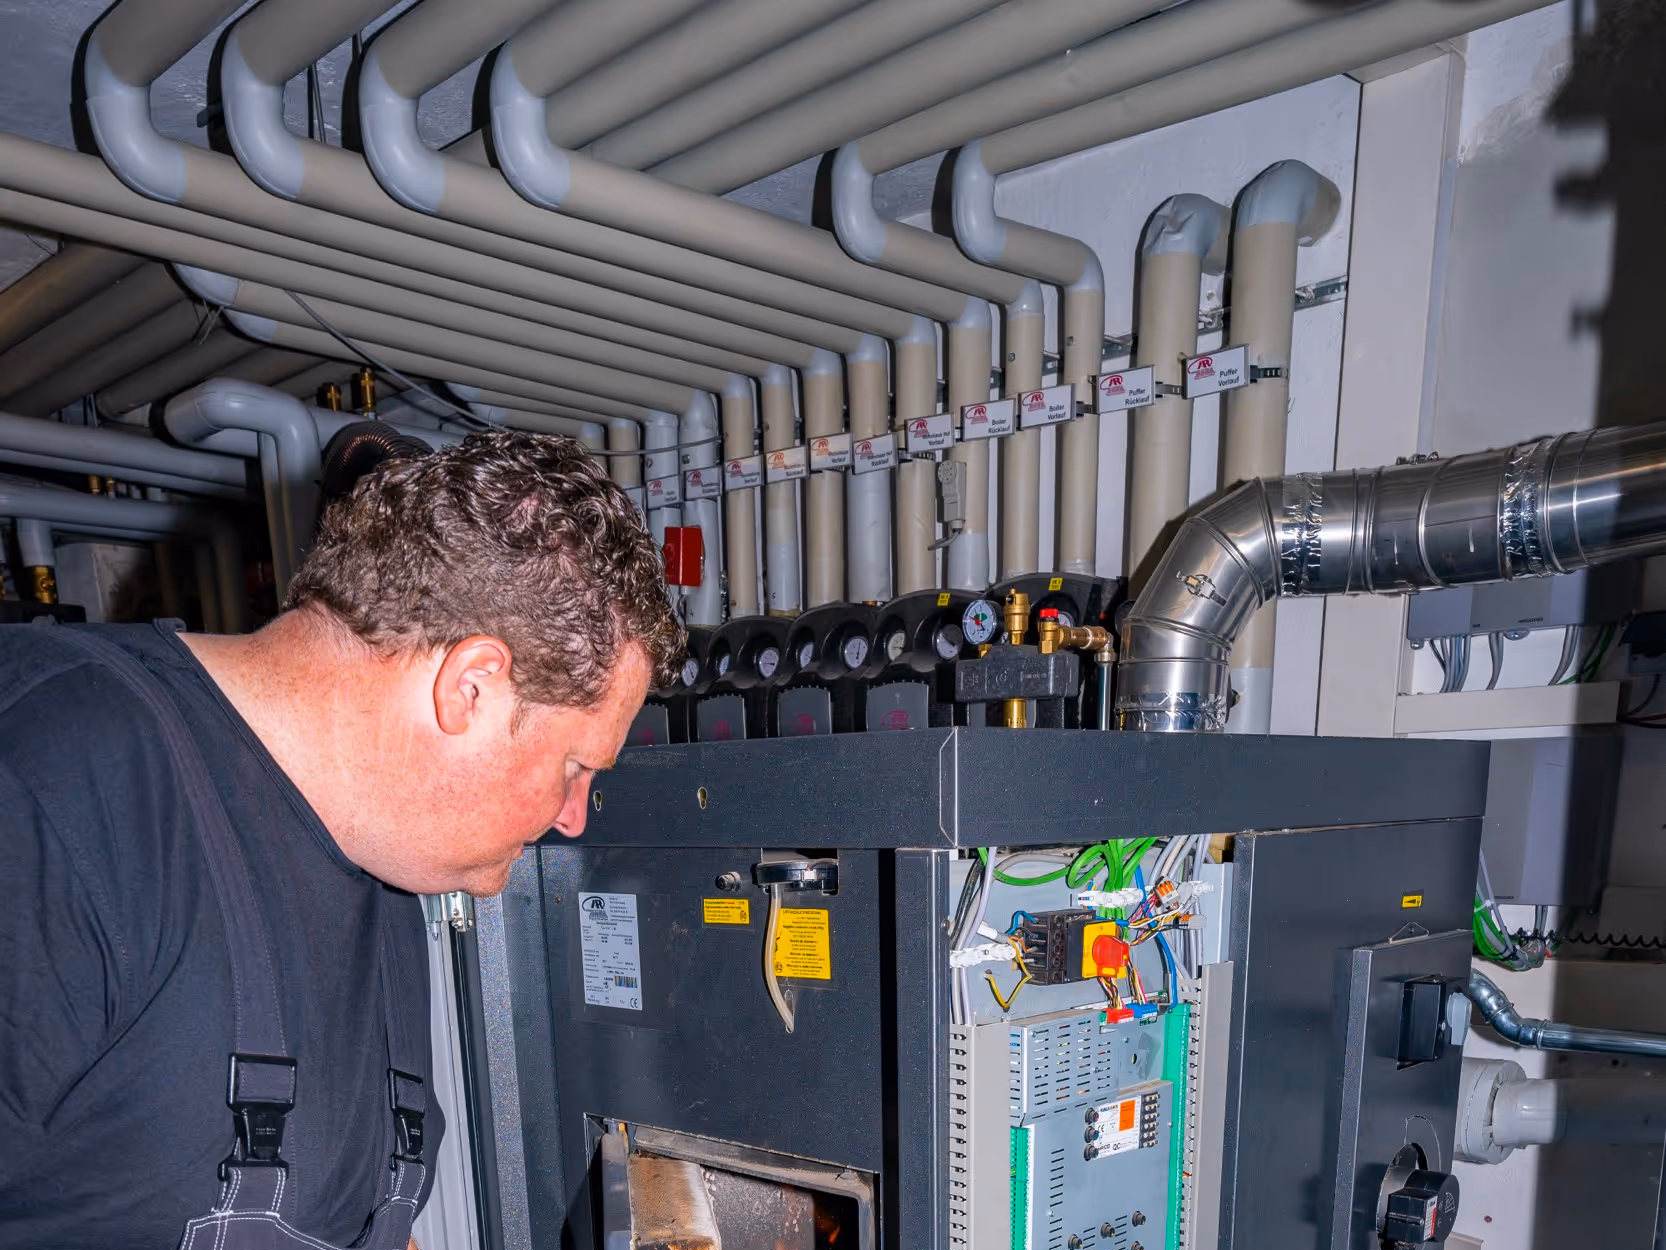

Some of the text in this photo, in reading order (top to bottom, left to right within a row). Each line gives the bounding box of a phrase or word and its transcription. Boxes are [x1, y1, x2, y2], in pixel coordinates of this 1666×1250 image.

[1219, 368, 1239, 378] Puffer
[1218, 376, 1240, 387] Vorlauf
[1128, 387, 1146, 396] Puffer
[1125, 395, 1150, 406] Rücklauf
[1048, 403, 1065, 412] Boiler
[1047, 411, 1067, 421] Vorlauf
[991, 418, 1007, 426] Boiler
[988, 425, 1011, 434] Rücklauf
